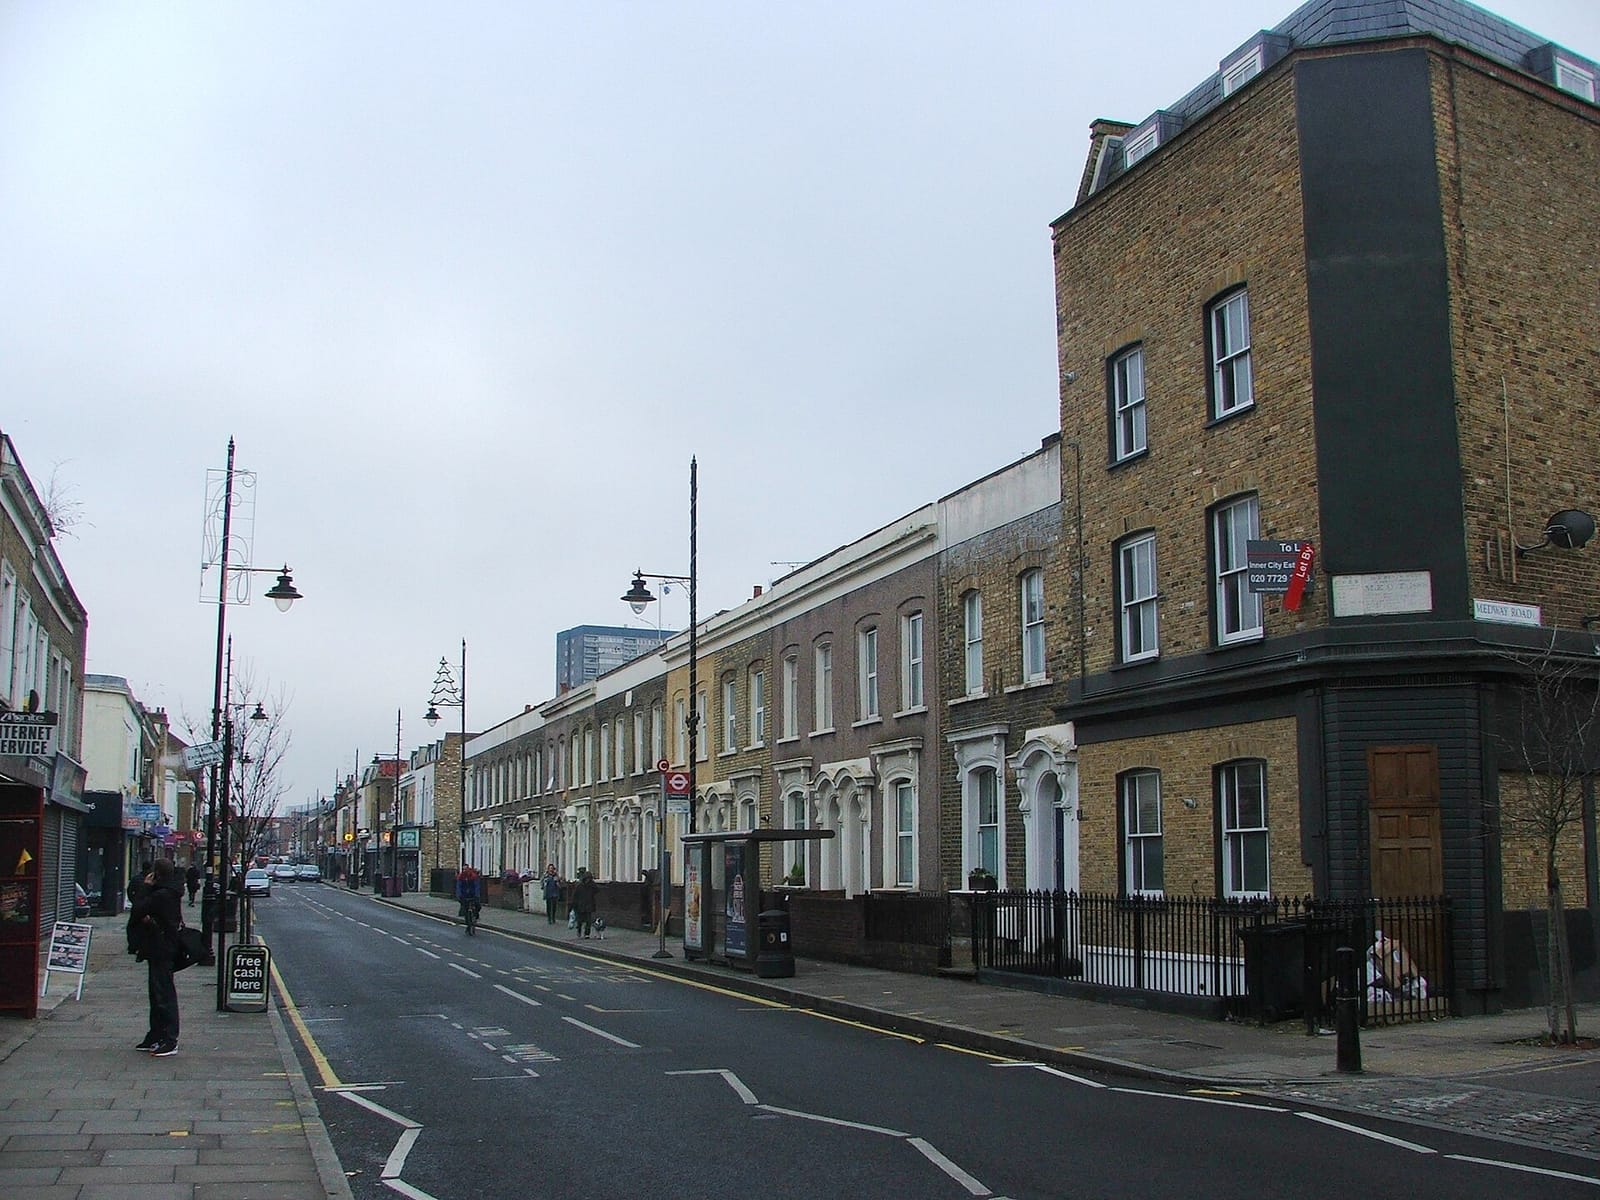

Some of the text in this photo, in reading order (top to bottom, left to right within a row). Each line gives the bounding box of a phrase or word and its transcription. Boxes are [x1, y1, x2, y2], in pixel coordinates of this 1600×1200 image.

[1279, 543, 1292, 553] To
[1301, 544, 1314, 561] By
[1249, 561, 1267, 569] Inner
[1267, 561, 1282, 570] City
[1250, 574, 1265, 583] 020
[1267, 574, 1288, 583] 7729
[1476, 602, 1533, 619] MEDWAY ROAD
[236, 954, 262, 966] free
[233, 966, 263, 978] cash
[233, 978, 261, 990] here
